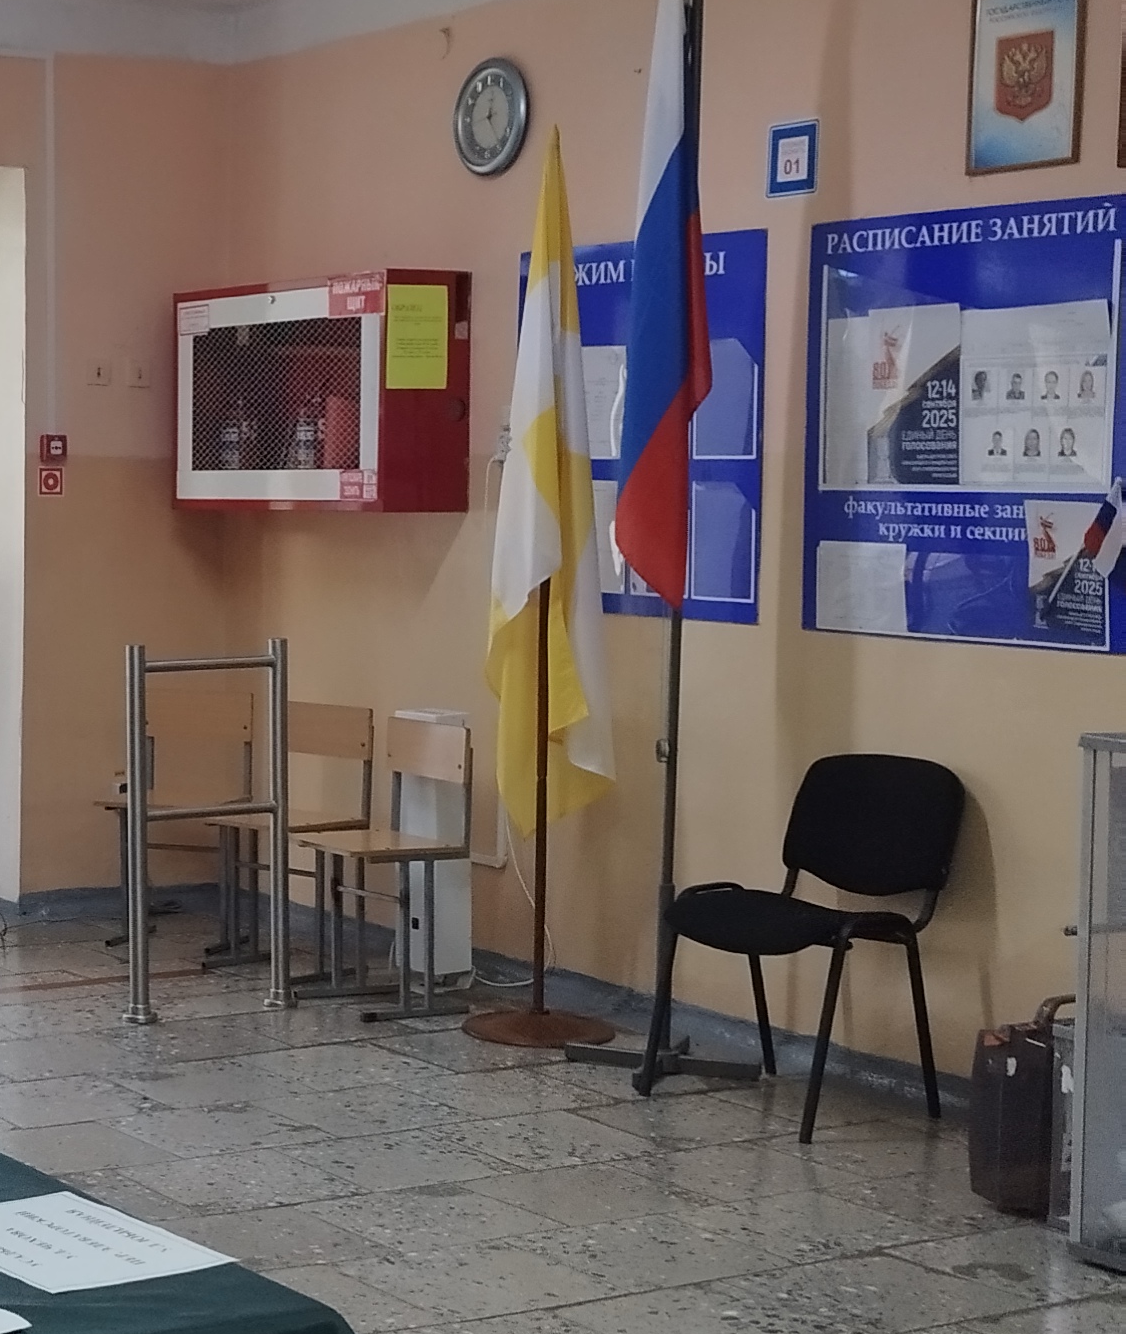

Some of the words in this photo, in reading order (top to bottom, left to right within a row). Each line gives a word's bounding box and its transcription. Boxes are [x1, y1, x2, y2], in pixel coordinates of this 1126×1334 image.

[783, 157, 800, 175] 01
[826, 219, 984, 255] РАСПИСАНИЕ
[987, 202, 1118, 241] ЗАНЯТИЙ
[574, 259, 626, 286] ЖИМ
[921, 409, 957, 428] 2025
[843, 495, 990, 519] факультативные
[993, 504, 1025, 519] зан
[878, 522, 945, 542] кружки
[949, 525, 962, 539] и
[1074, 579, 1103, 596] 2025
